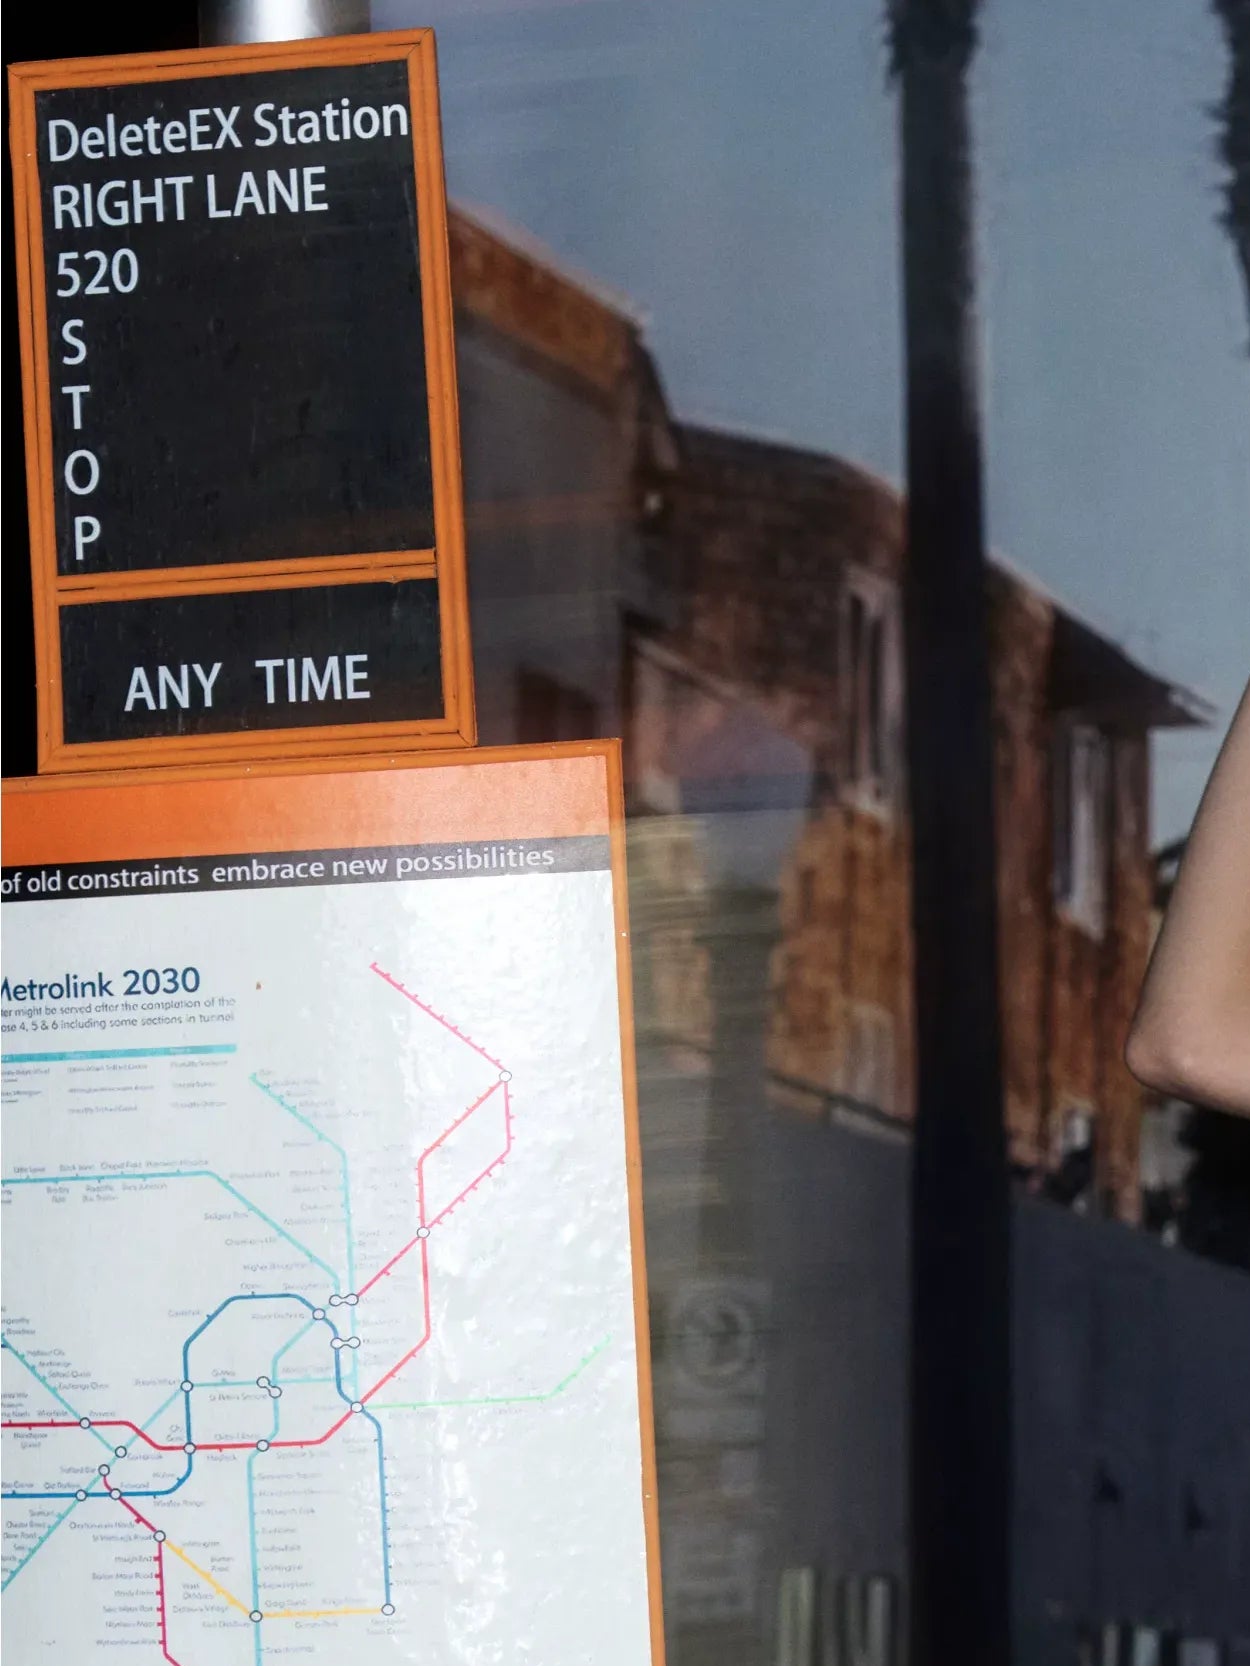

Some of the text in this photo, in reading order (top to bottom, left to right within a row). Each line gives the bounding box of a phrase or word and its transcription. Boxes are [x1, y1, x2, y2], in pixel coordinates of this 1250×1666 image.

[48, 98, 409, 163] DeleteEX Station
[53, 166, 329, 230] RIGHT LANE
[56, 249, 139, 299] 520
[124, 654, 372, 713] ANY TIME
[27, 870, 61, 893] old
[67, 864, 200, 890] constraints
[212, 859, 325, 884] embrace
[332, 855, 388, 878] new
[396, 845, 556, 878] possibilities
[122, 966, 201, 996] 2030
[15, 1005, 42, 1018] might
[45, 1005, 57, 1016] be
[59, 1003, 92, 1015] served
[95, 1001, 119, 1013] after
[121, 1001, 139, 1011] the
[204, 997, 215, 1008] of
[217, 996, 236, 1007] the
[31, 1021, 39, 1031] 5
[51, 1021, 59, 1030] 6
[61, 1019, 107, 1030] including
[109, 1018, 138, 1027] some
[141, 1015, 183, 1026] sections
[186, 1014, 196, 1024] in
[199, 1013, 234, 1023] tunnel
